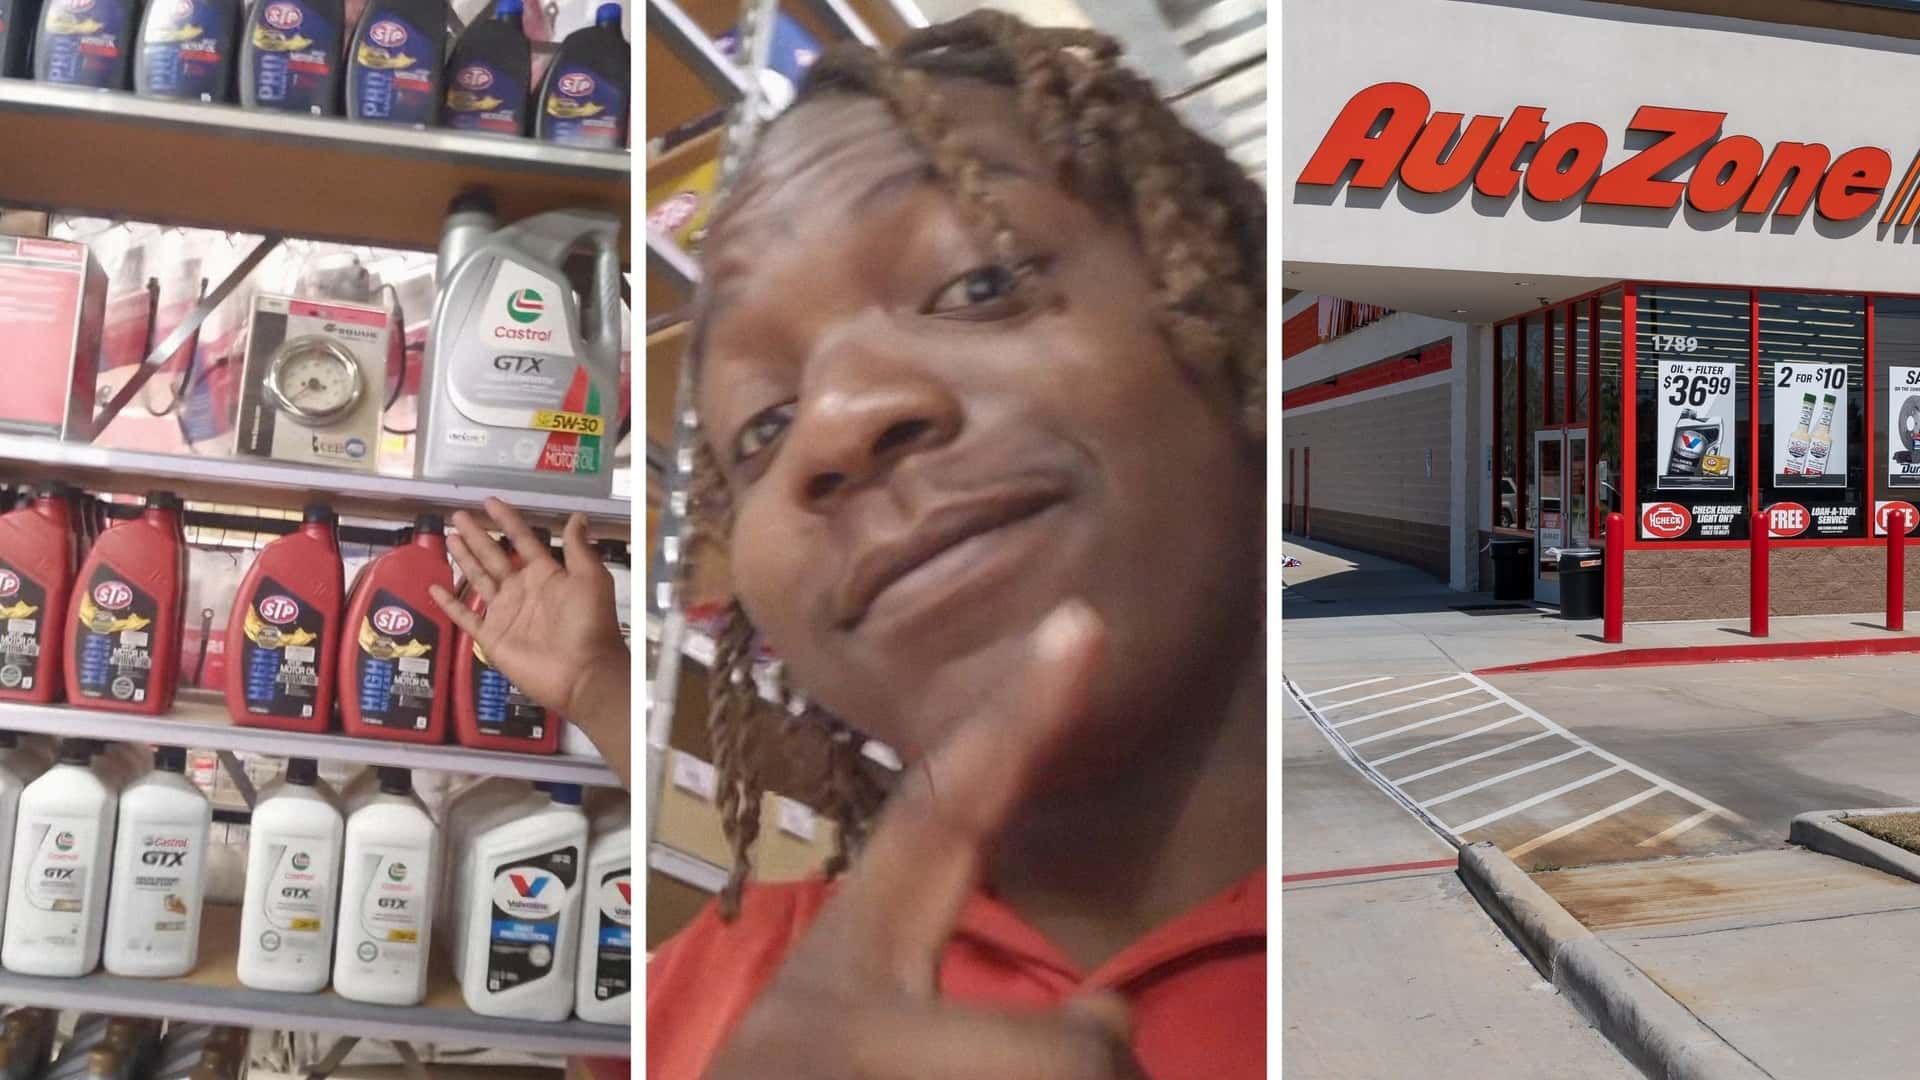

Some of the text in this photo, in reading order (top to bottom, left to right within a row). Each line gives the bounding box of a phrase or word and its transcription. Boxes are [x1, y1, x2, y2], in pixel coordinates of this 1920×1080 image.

[374, 25, 403, 43] STP
[563, 76, 590, 93] STP
[1296, 82, 1893, 221] AutoZone
[494, 326, 553, 342] Castrol
[1652, 336, 1698, 352] 1789
[493, 355, 545, 374] GTX
[1670, 364, 1685, 374] OIL
[1695, 366, 1724, 375] FILTER
[1777, 366, 1846, 390] 2 FOR $10
[551, 414, 599, 432] 5W-30
[545, 451, 579, 469] MOTOR
[1692, 506, 1743, 514] CHECK ENGINE
[1697, 514, 1734, 523] LIGHT ON?
[1811, 507, 1857, 516] LOAN-A-TOOL
[1655, 516, 1681, 525] CHECK
[1771, 509, 1803, 529] FREE
[1817, 515, 1849, 524] SERVICE
[99, 585, 129, 604] STP
[265, 600, 294, 619] STP
[379, 609, 409, 630] STP
[360, 659, 384, 711] HIGH
[154, 837, 188, 848] Castrol
[142, 850, 187, 867] GTX
[44, 867, 75, 880] GTX
[281, 887, 311, 899] GTX
[378, 897, 409, 910] GTX
